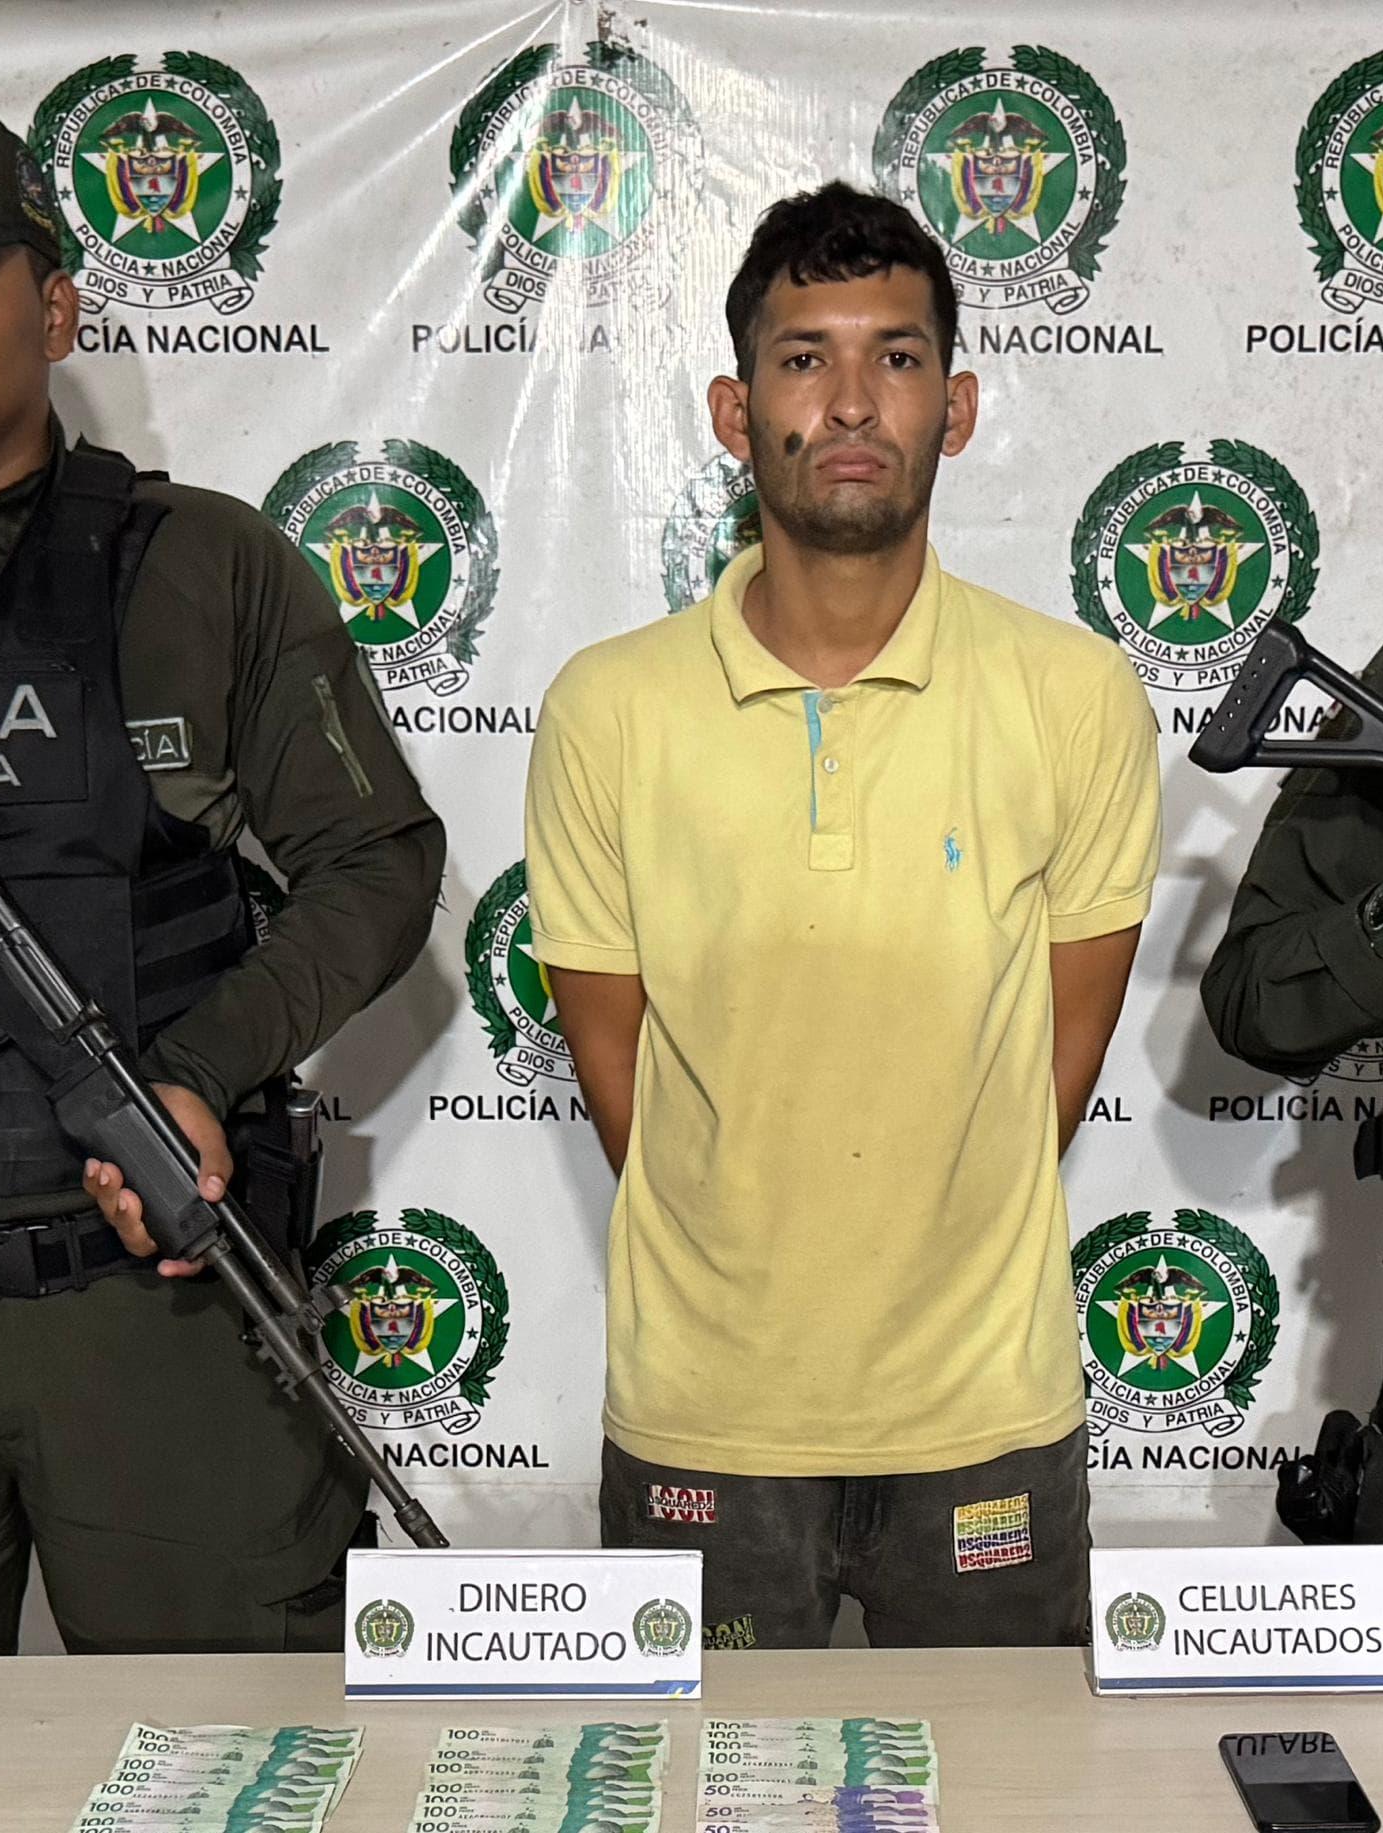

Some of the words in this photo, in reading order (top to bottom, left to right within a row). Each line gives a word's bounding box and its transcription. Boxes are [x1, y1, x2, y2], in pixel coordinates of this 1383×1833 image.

[147, 325, 329, 353] NACIONAL
[412, 317, 537, 353] POLICÍ
[981, 325, 1163, 353] NACIONAL
[393, 707, 536, 733] ACIONAL
[430, 1089, 560, 1121] POLICÍA
[1209, 1090, 1343, 1121] POLICÍA
[383, 1443, 549, 1468] NACIONAL
[460, 1583, 586, 1612] DINERO
[1179, 1584, 1356, 1612] CELULARES
[427, 1632, 626, 1661] INCAUTADO
[1174, 1627, 1382, 1655] INCAUTADOS
[448, 1729, 479, 1740] 100
[138, 1741, 170, 1753] 100
[437, 1751, 469, 1760] 100
[708, 1752, 741, 1764] 100
[122, 1759, 155, 1769] 100
[428, 1763, 462, 1774] 100
[116, 1772, 150, 1782] 100
[705, 1773, 738, 1782] 100
[100, 1784, 134, 1795] 100
[430, 1784, 462, 1793] 100
[704, 1785, 730, 1796] 50
[89, 1802, 123, 1813] 100
[424, 1806, 457, 1818] 100
[705, 1807, 732, 1817] 50
[416, 1822, 449, 1833] 100
